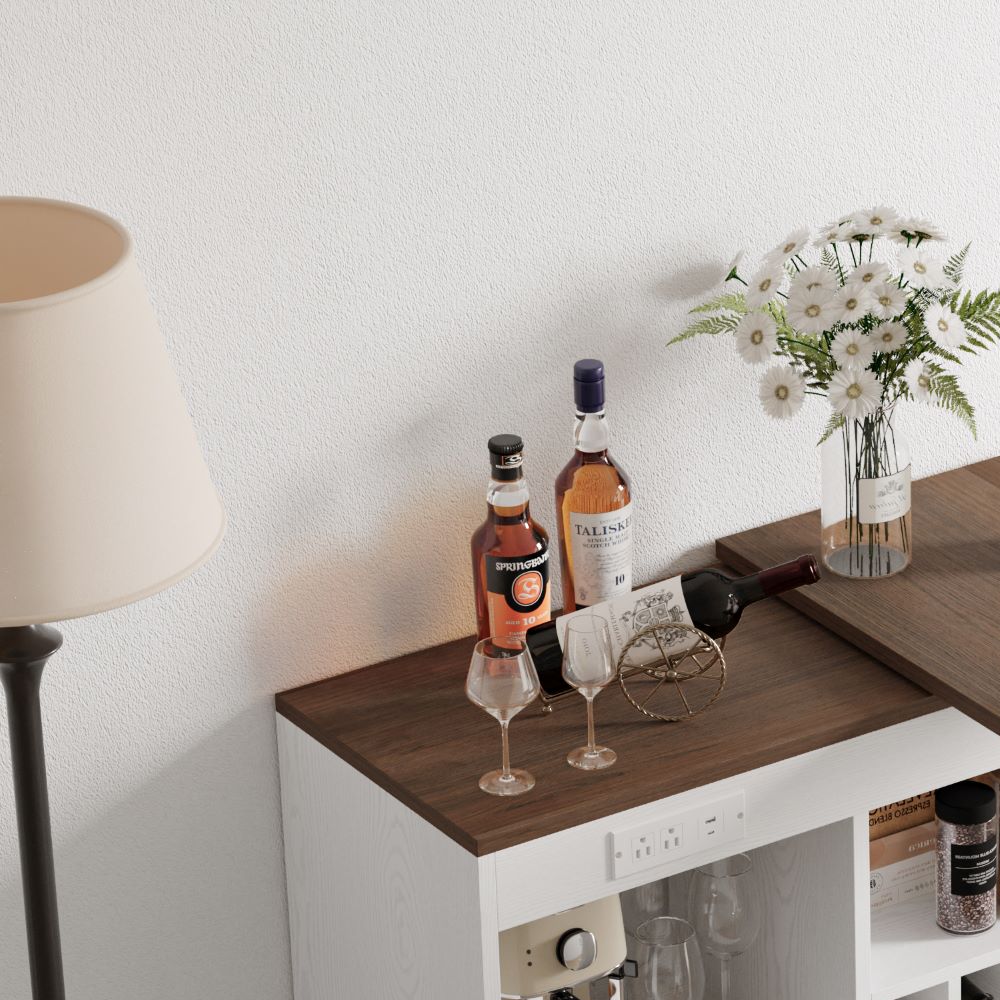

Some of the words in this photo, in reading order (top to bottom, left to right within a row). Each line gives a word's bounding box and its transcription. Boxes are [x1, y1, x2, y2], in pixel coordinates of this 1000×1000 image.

[575, 515, 632, 536] TALISKE
[615, 574, 625, 586] 10
[522, 616, 537, 626] 10
